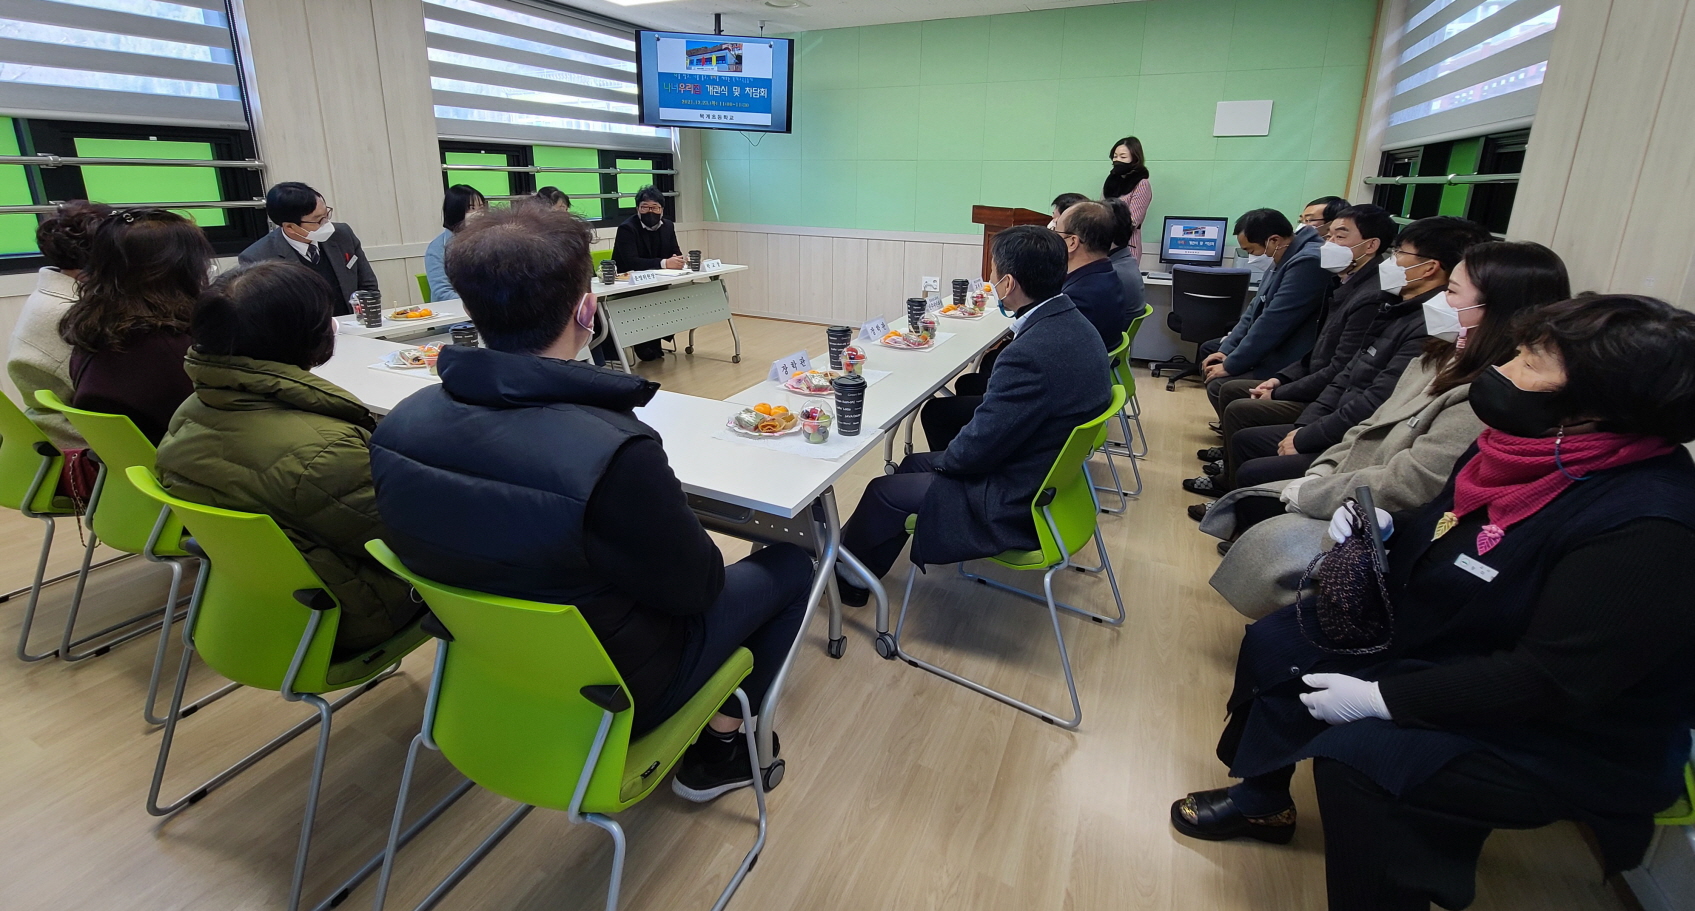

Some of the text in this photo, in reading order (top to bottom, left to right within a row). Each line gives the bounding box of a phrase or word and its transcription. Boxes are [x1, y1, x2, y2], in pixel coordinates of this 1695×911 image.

[663, 82, 701, 94] 나너우리집
[706, 84, 728, 96] 개관식
[732, 86, 741, 97] 및
[781, 355, 807, 375] 장학관
